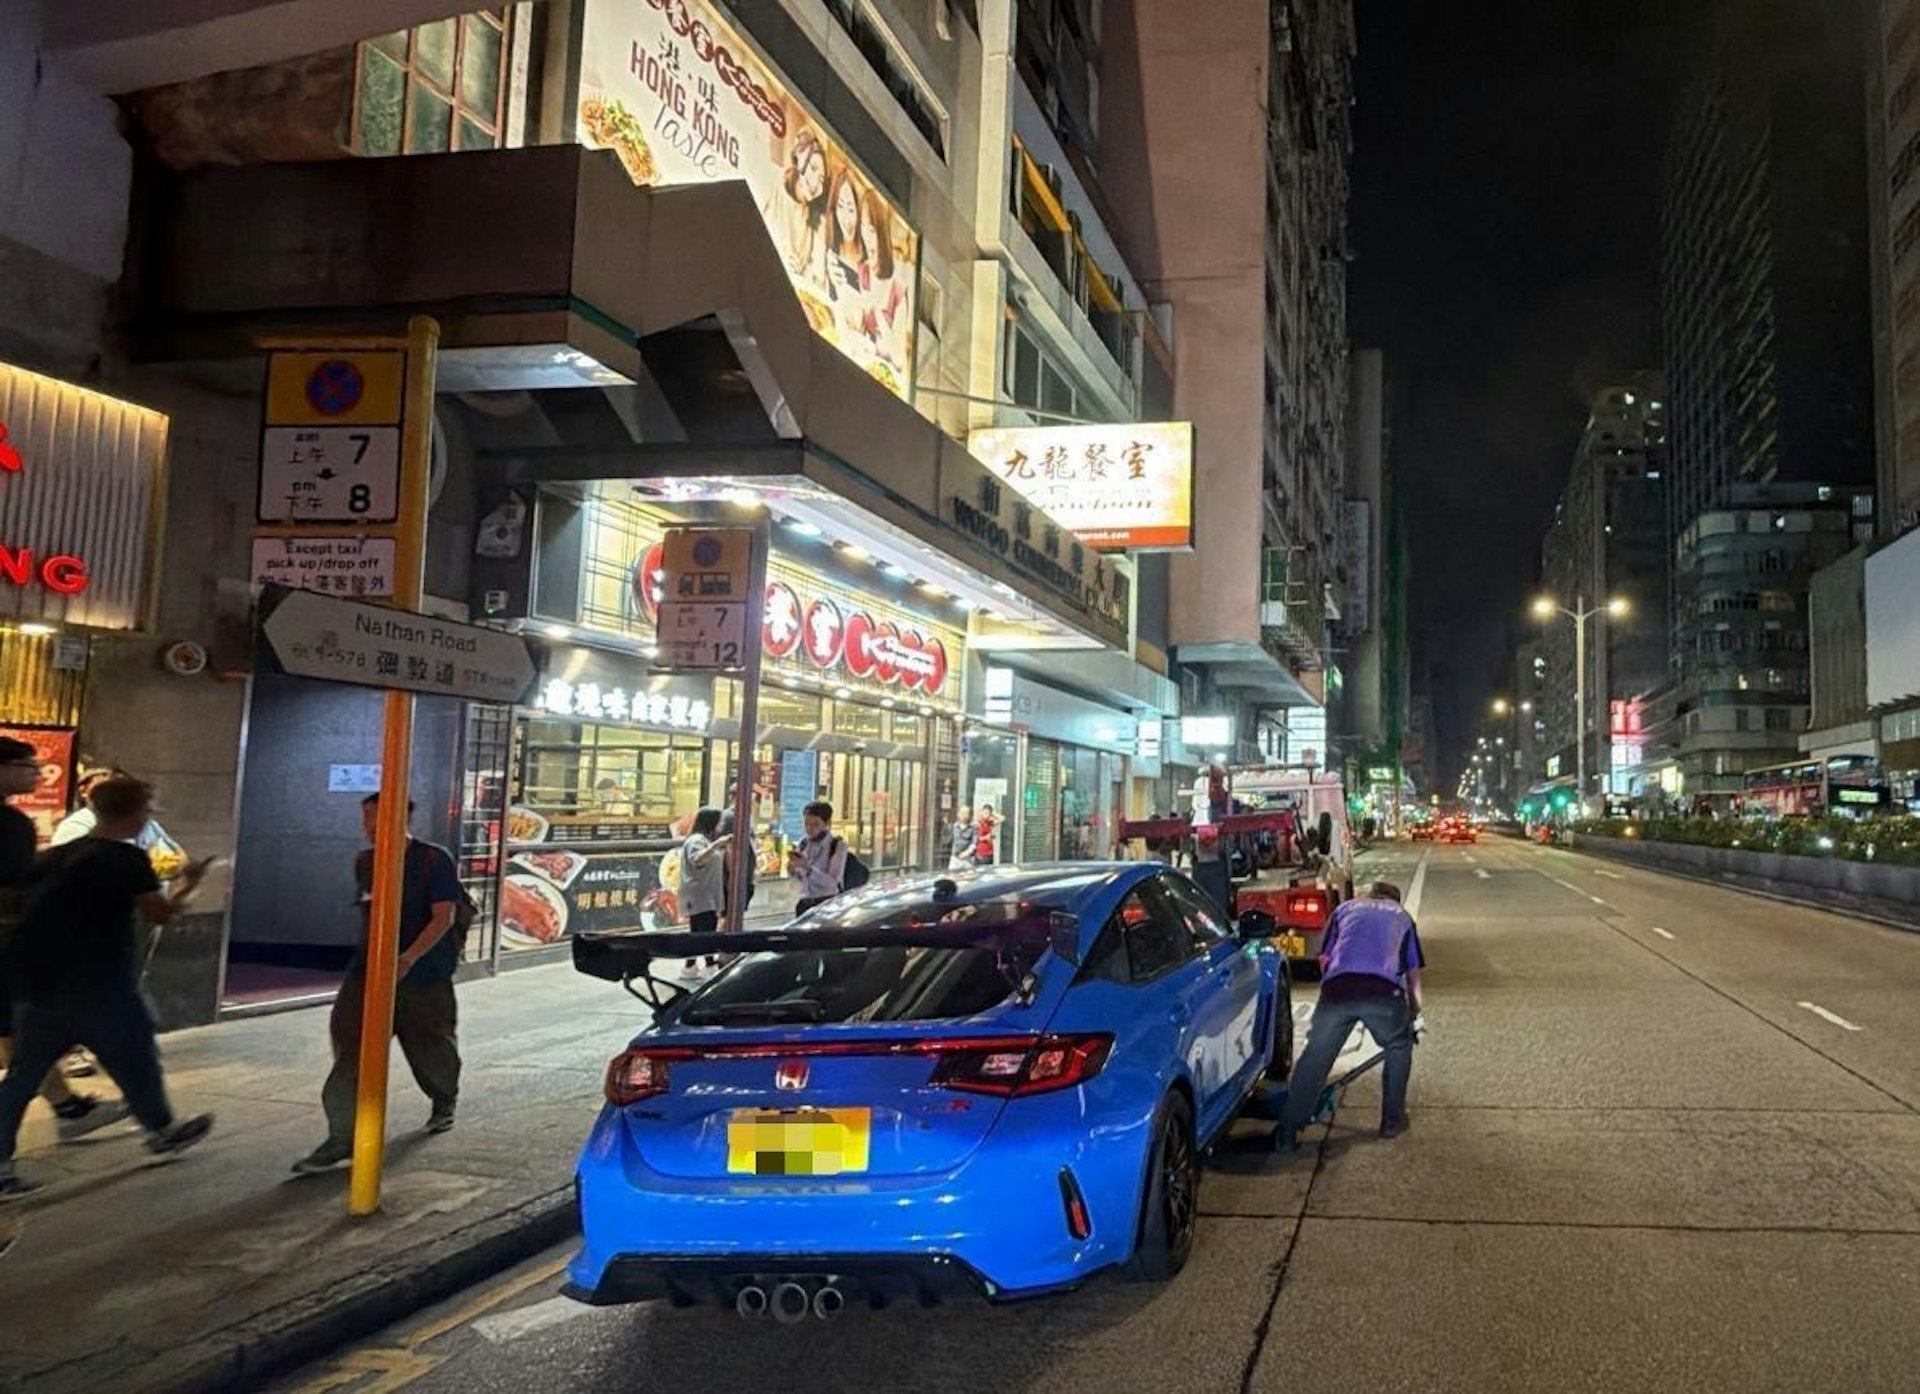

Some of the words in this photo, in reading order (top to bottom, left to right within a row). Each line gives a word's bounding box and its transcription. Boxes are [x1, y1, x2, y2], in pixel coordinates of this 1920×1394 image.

[631, 40, 687, 120] HONG
[692, 100, 741, 169] KONG
[287, 446, 325, 464] 上午
[349, 434, 371, 465] 7
[1005, 440, 1154, 481] 九龍餐室
[285, 496, 323, 515] 下午
[348, 483, 371, 513] 8
[286, 543, 332, 556] Except
[337, 543, 363, 554] taxi
[266, 558, 298, 569] pick
[359, 559, 379, 569] off
[714, 607, 728, 628] 7
[356, 612, 425, 646] Nathan
[430, 627, 477, 652] Road
[713, 642, 738, 663] 12
[376, 650, 454, 686] 彌敦道
